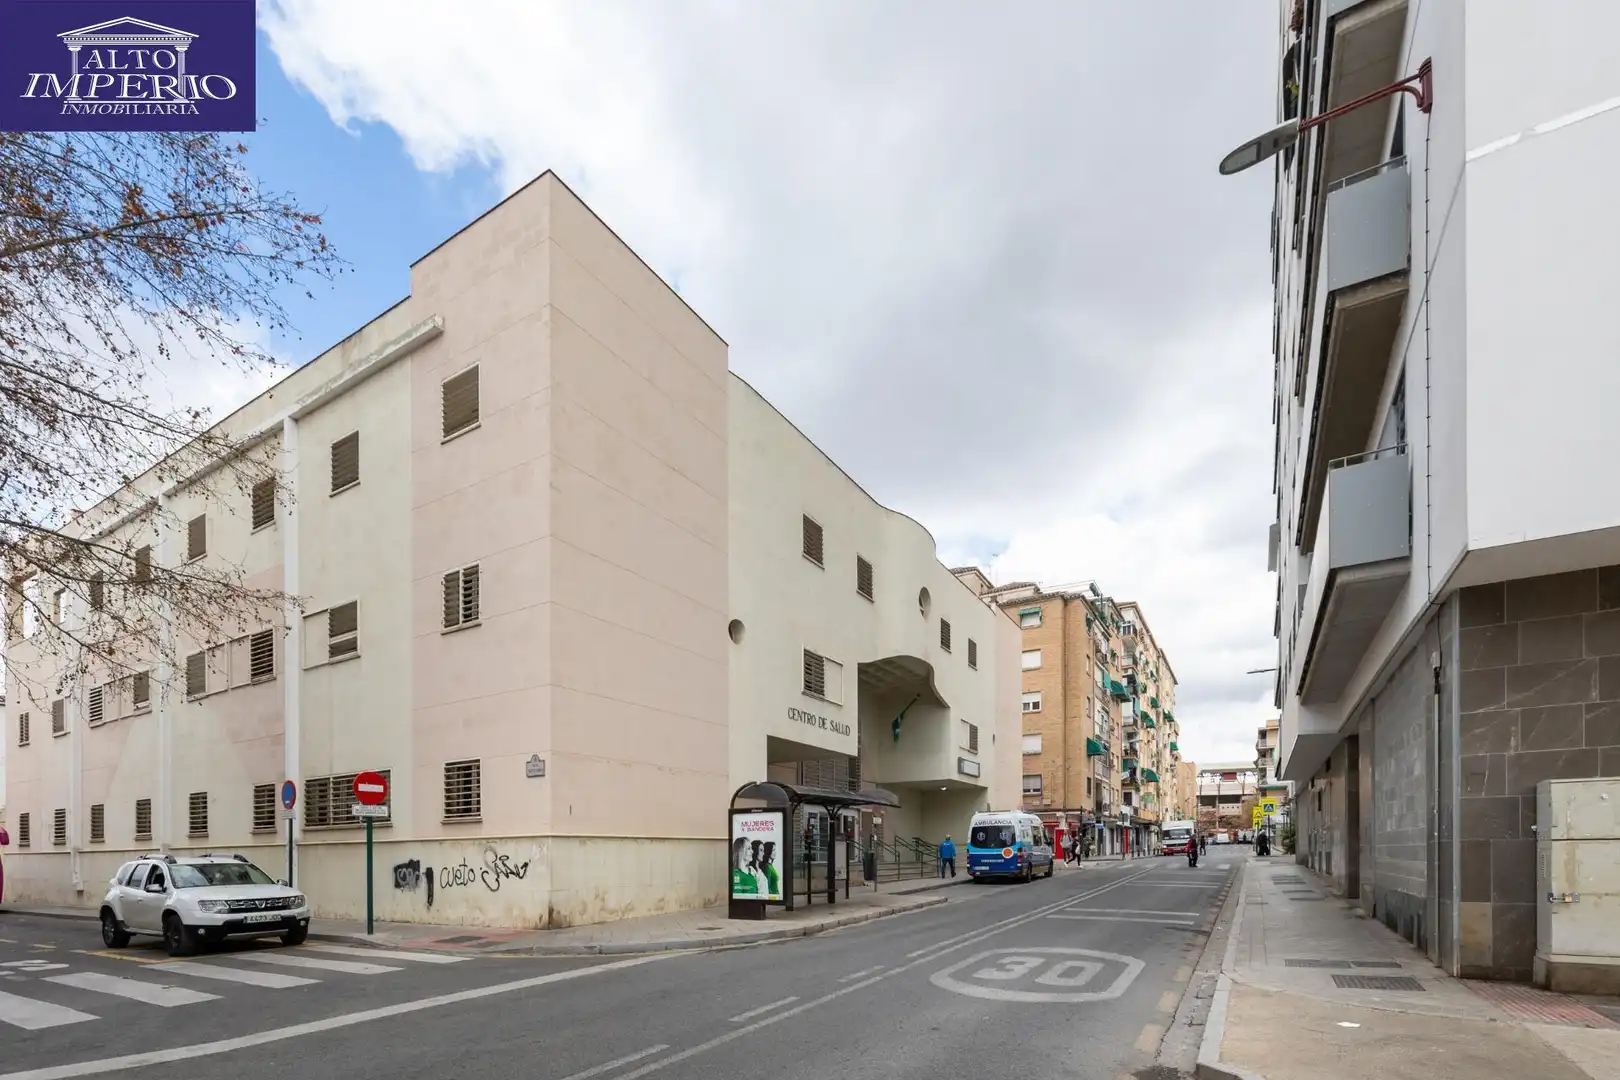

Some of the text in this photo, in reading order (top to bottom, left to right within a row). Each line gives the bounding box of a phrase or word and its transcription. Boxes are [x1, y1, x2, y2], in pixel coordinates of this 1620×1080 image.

[787, 707, 851, 737] CENTRO DE SALUD
[741, 820, 775, 828] MUJERES
[974, 819, 1013, 827] AMBULANCIA
[972, 956, 1104, 986] 30
